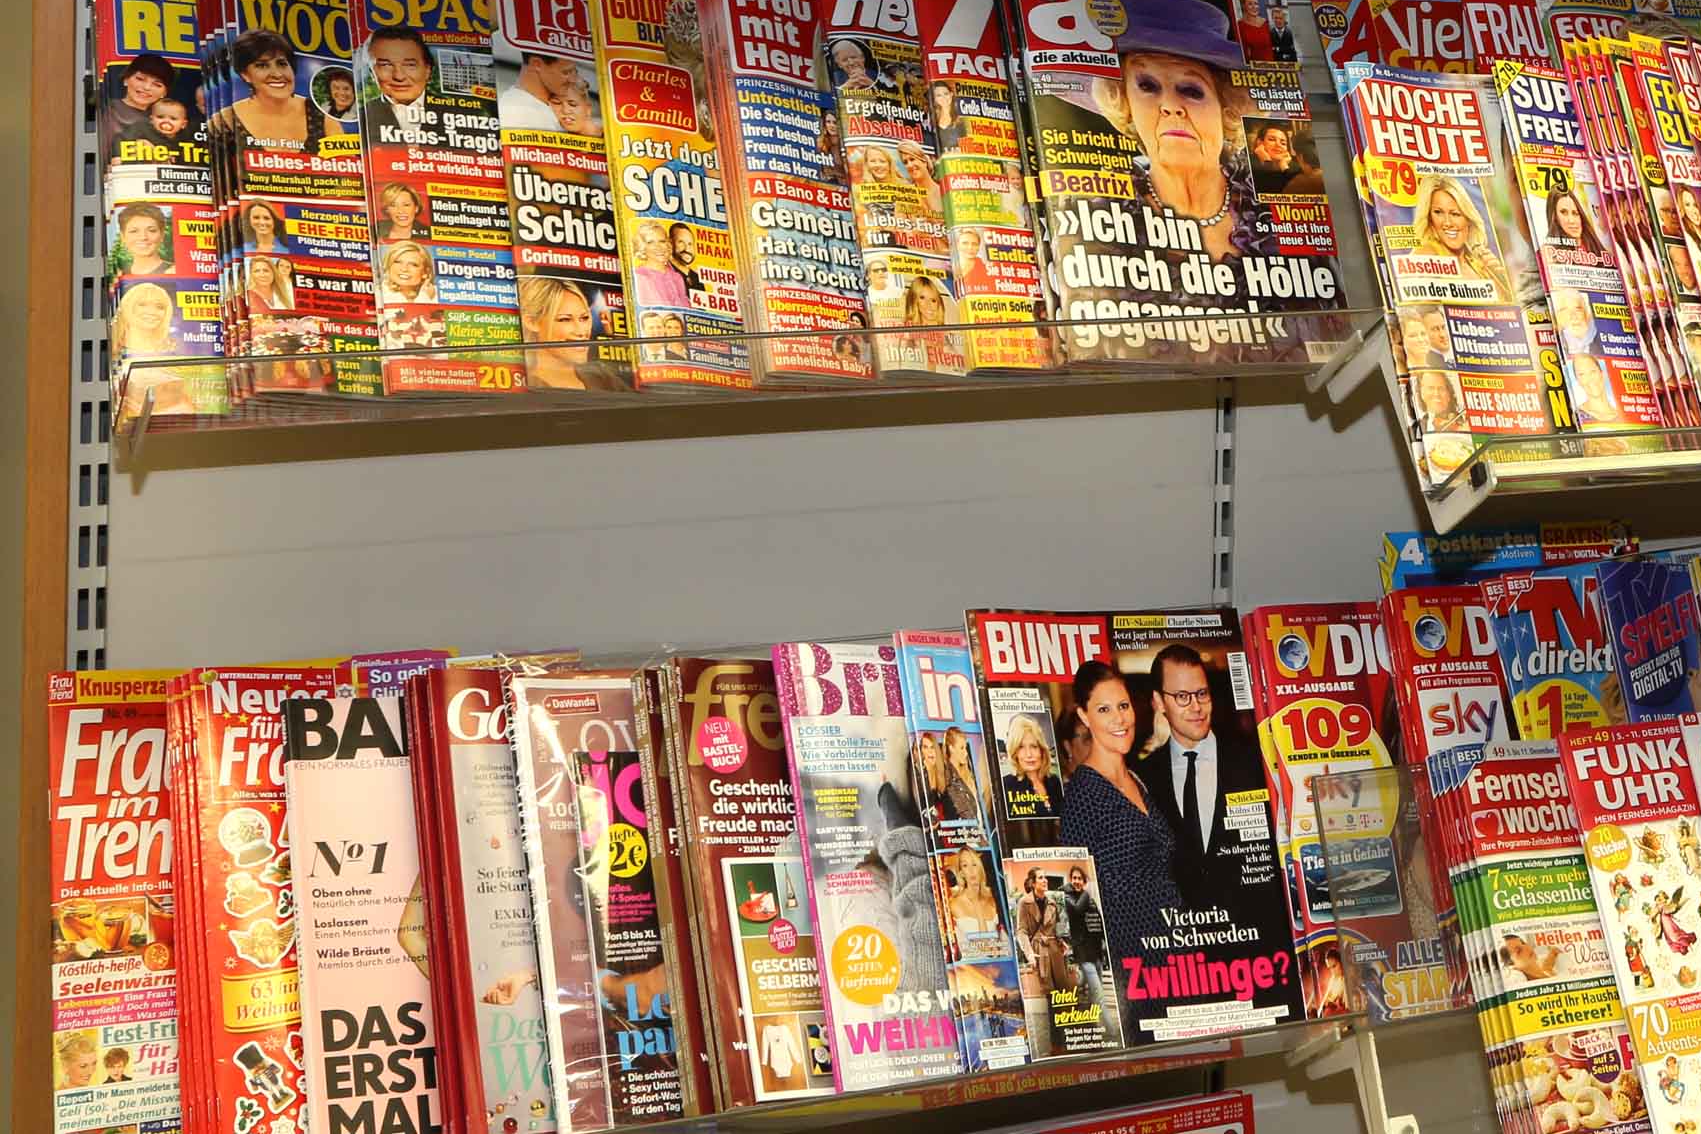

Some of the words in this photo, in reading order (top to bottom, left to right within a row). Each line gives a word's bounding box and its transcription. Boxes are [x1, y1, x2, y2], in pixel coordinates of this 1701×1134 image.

[740, 14, 800, 43] mit
[1033, 51, 1056, 65] die
[1060, 51, 1117, 67] aktuelle
[615, 64, 687, 89] Charles
[1232, 70, 1299, 88] Bitte??!!
[737, 89, 821, 116] Untröstlich
[1363, 82, 1483, 125] WOCHE
[407, 107, 438, 128] Die
[444, 113, 499, 134] ganze
[619, 104, 693, 129] Camilla
[621, 134, 672, 158] Jetzt
[745, 139, 798, 161] Freundin
[801, 147, 834, 167] bricht
[1371, 122, 1488, 165] HEUTE
[1046, 149, 1133, 171] Schweigen!
[1049, 172, 1131, 198] Beatrix
[1055, 203, 1137, 246] »Ich
[1146, 207, 1201, 250] bin
[1063, 251, 1172, 295] durch
[1182, 254, 1236, 296] die
[1246, 257, 1335, 300] Hölle
[1397, 257, 1457, 277] Abschied
[1402, 283, 1428, 299] von
[1431, 282, 1452, 299] der
[1456, 281, 1494, 301] Bühne?
[1450, 319, 1499, 339] Liebes-
[1455, 336, 1528, 357] Ultimatum
[984, 619, 1101, 676] BUNTE
[1528, 643, 1613, 675] direkt
[1277, 681, 1354, 696] XXL-AUSGABE
[553, 697, 596, 711] DaWanda
[1282, 703, 1372, 750] 109
[711, 755, 739, 767] BUCH
[1575, 741, 1686, 781] FUNK
[1596, 777, 1680, 811] UHR
[700, 817, 746, 835] Freude
[314, 916, 368, 929] Loslassen
[1160, 907, 1229, 928] Victoria
[845, 934, 882, 961] 20
[1141, 933, 1163, 950] von
[1166, 927, 1258, 948] Schweden
[317, 948, 346, 960] Wilde
[348, 945, 390, 957] Bräute
[58, 959, 142, 976] Köstlich-heiße
[1123, 951, 1290, 1001] Zwillinge?
[321, 1002, 427, 1052] DAS
[1540, 1006, 1614, 1030] sicherer!
